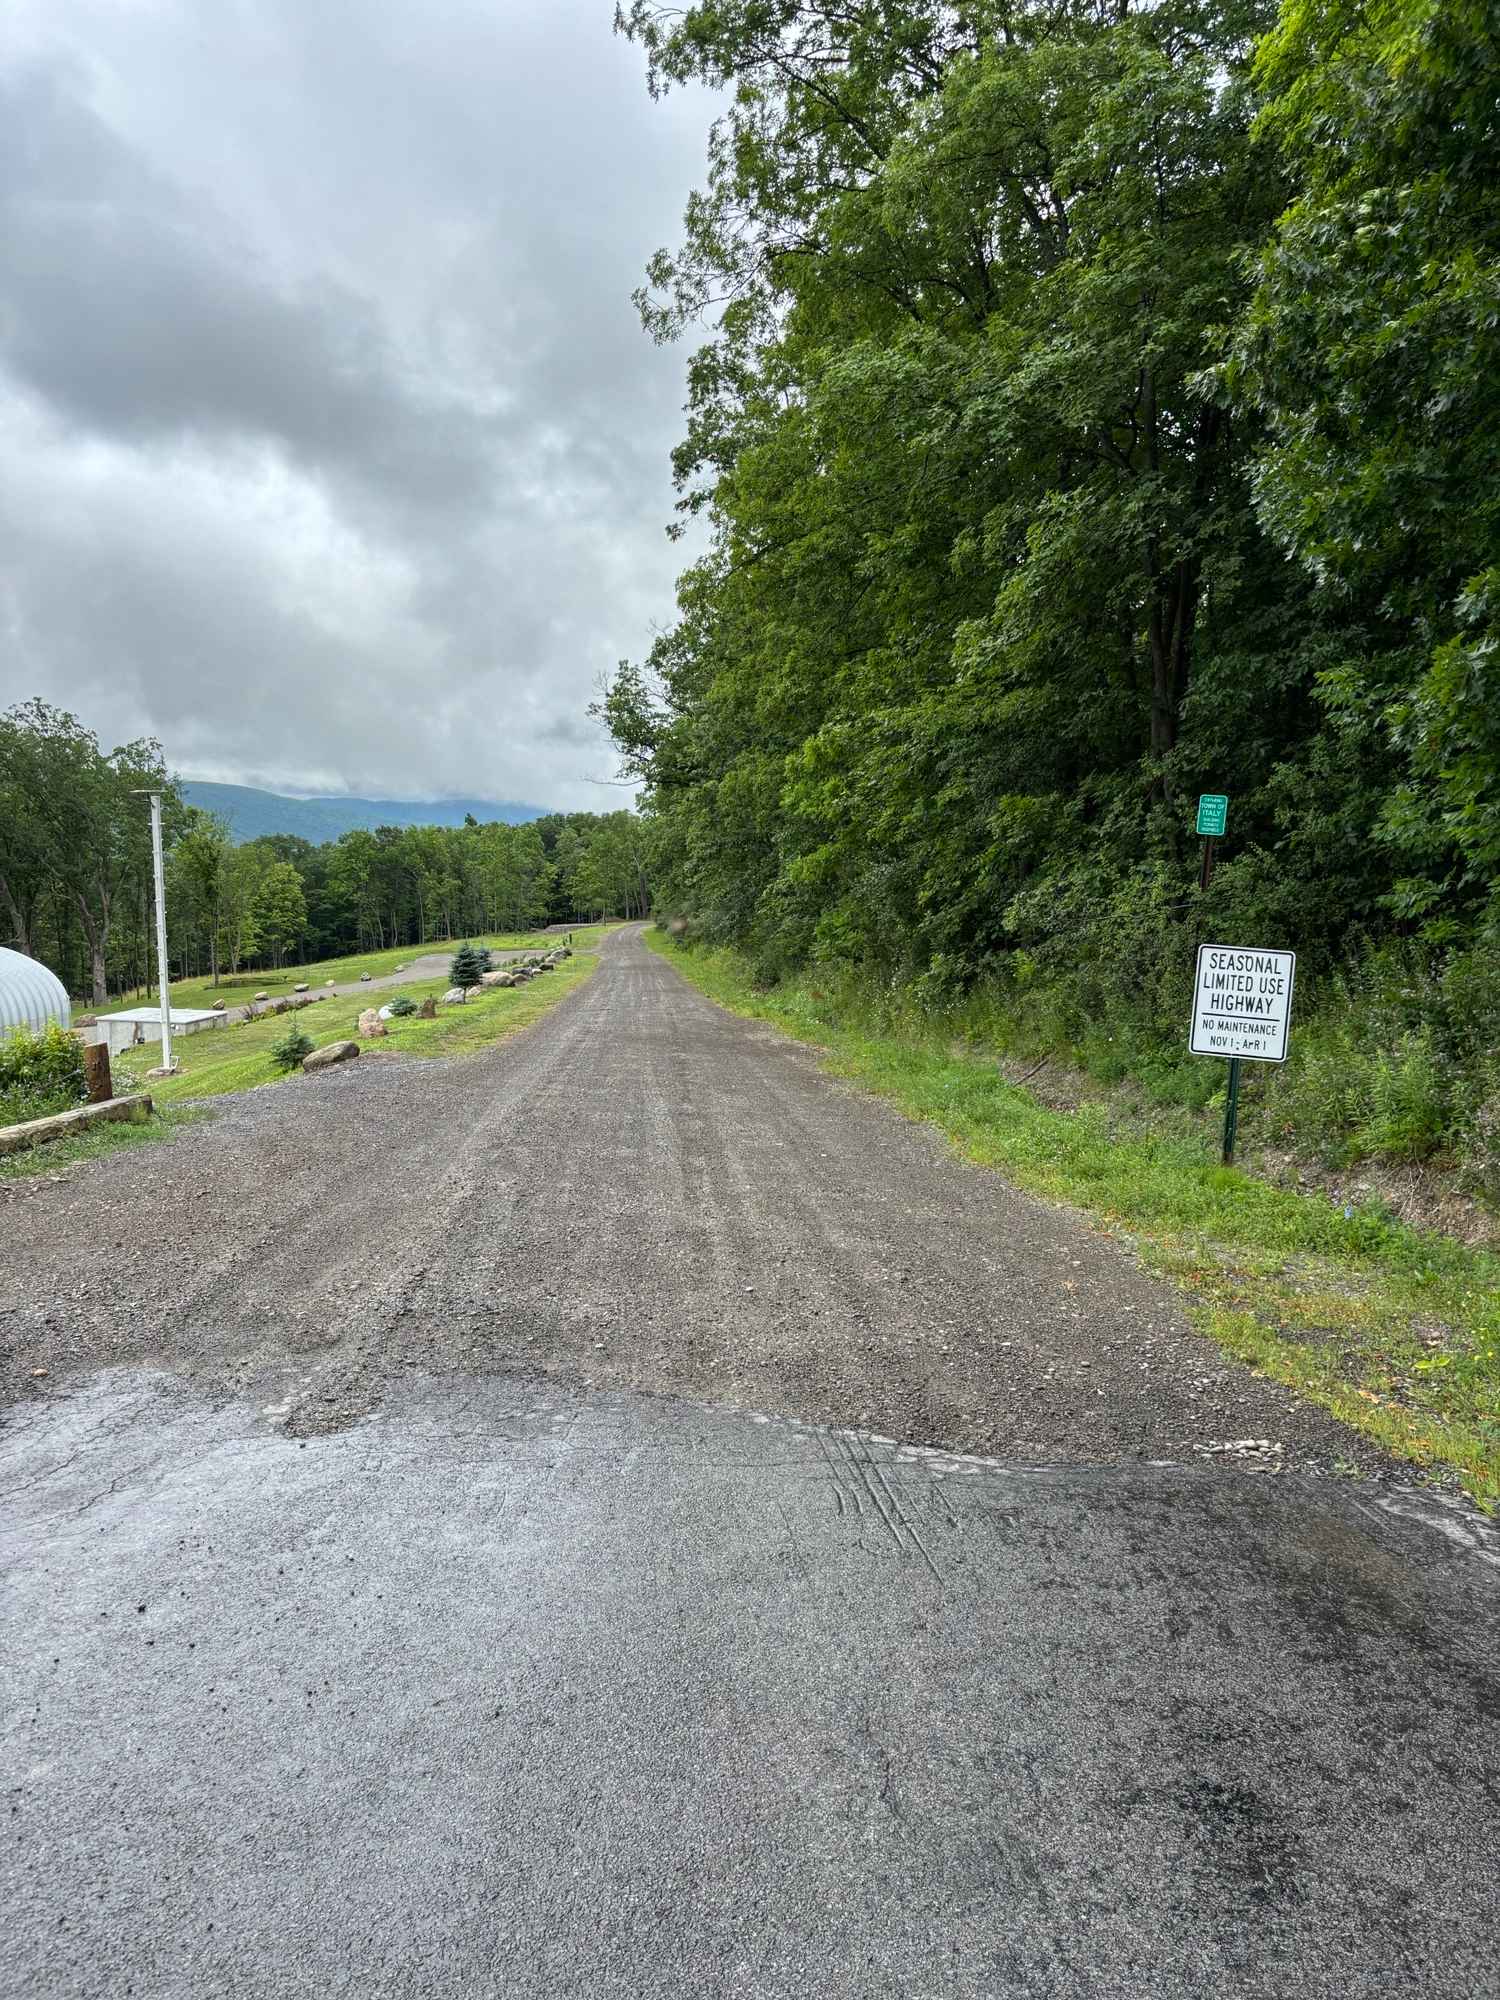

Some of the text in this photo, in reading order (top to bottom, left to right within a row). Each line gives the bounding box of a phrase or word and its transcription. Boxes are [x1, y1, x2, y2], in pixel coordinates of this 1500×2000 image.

[1209, 952, 1282, 974] SEASONAL
[1203, 972, 1284, 995] LIMITED USE
[1210, 993, 1274, 1014] HIGHWAY
[1202, 1019, 1277, 1036] NO MAINTENANCE
[1210, 1035, 1227, 1047] NOV
